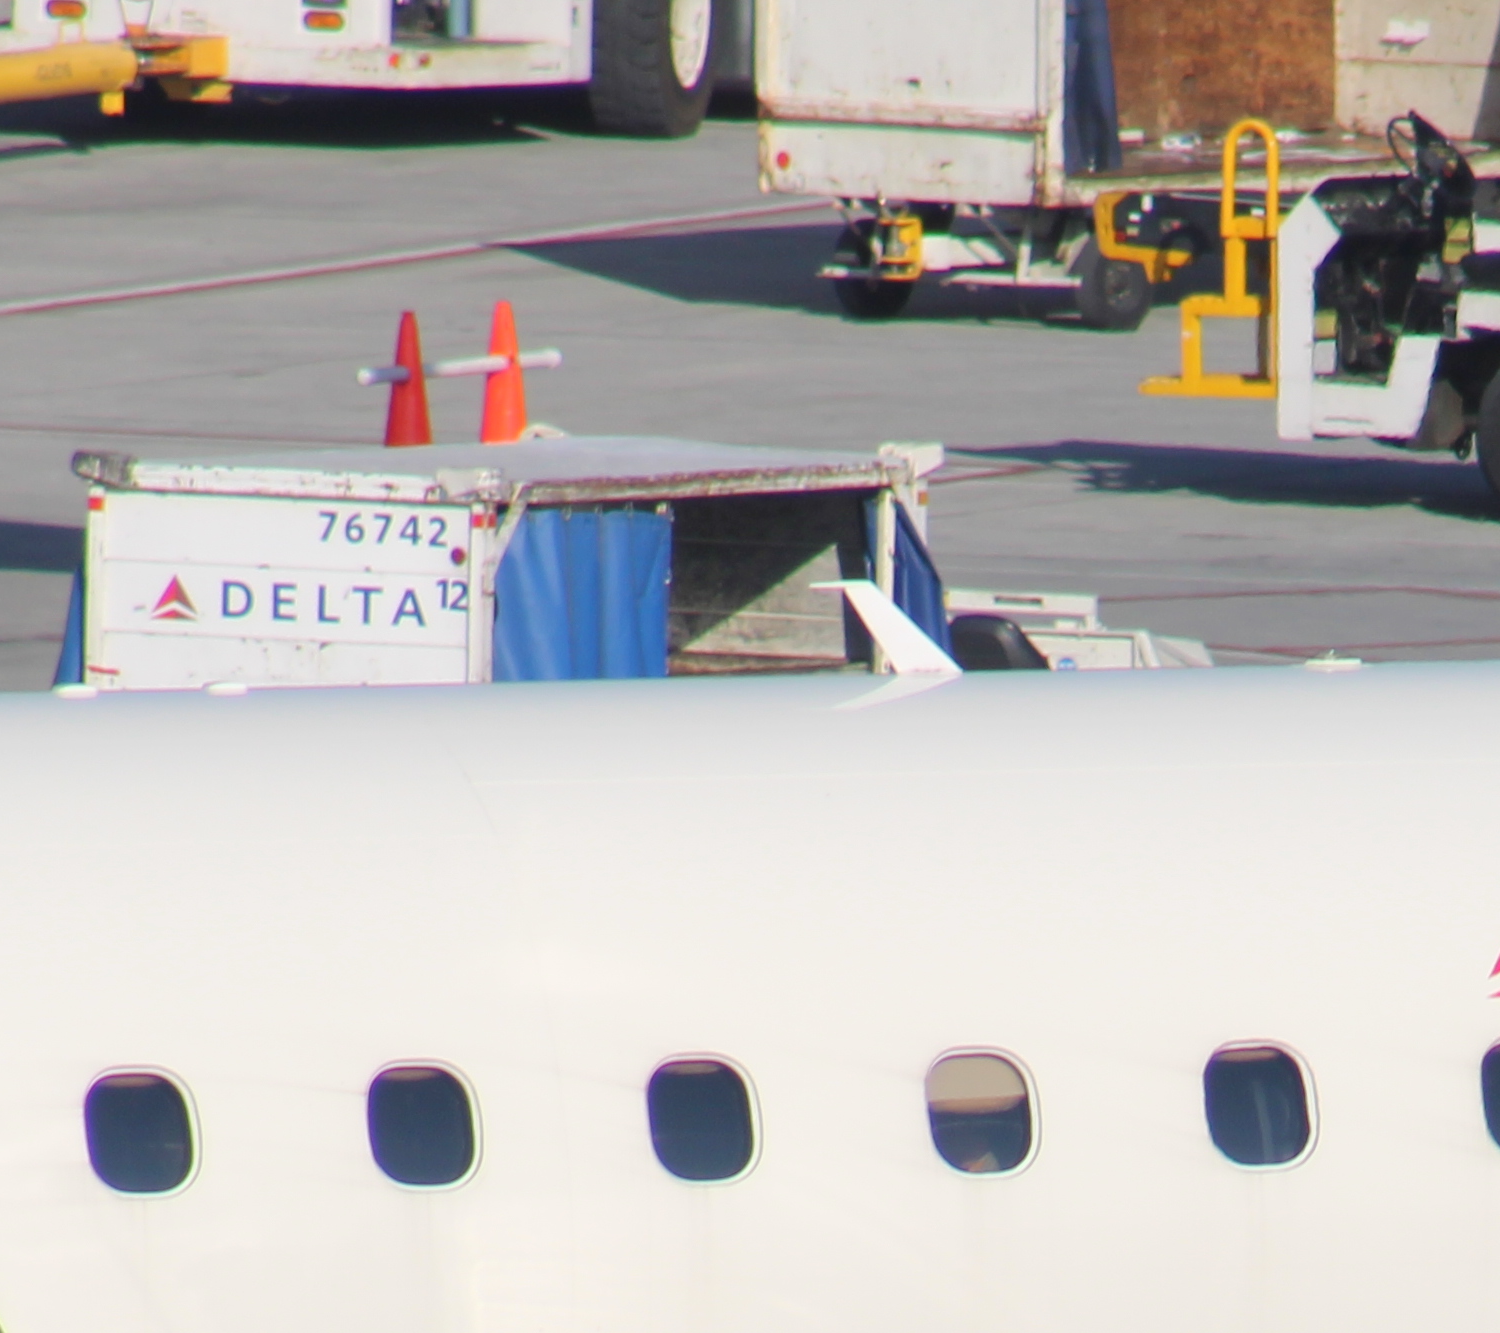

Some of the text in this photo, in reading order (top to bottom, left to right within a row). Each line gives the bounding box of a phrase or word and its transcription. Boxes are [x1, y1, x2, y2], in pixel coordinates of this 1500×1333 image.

[319, 511, 448, 548] 76742
[221, 579, 469, 626] DELTA 12
